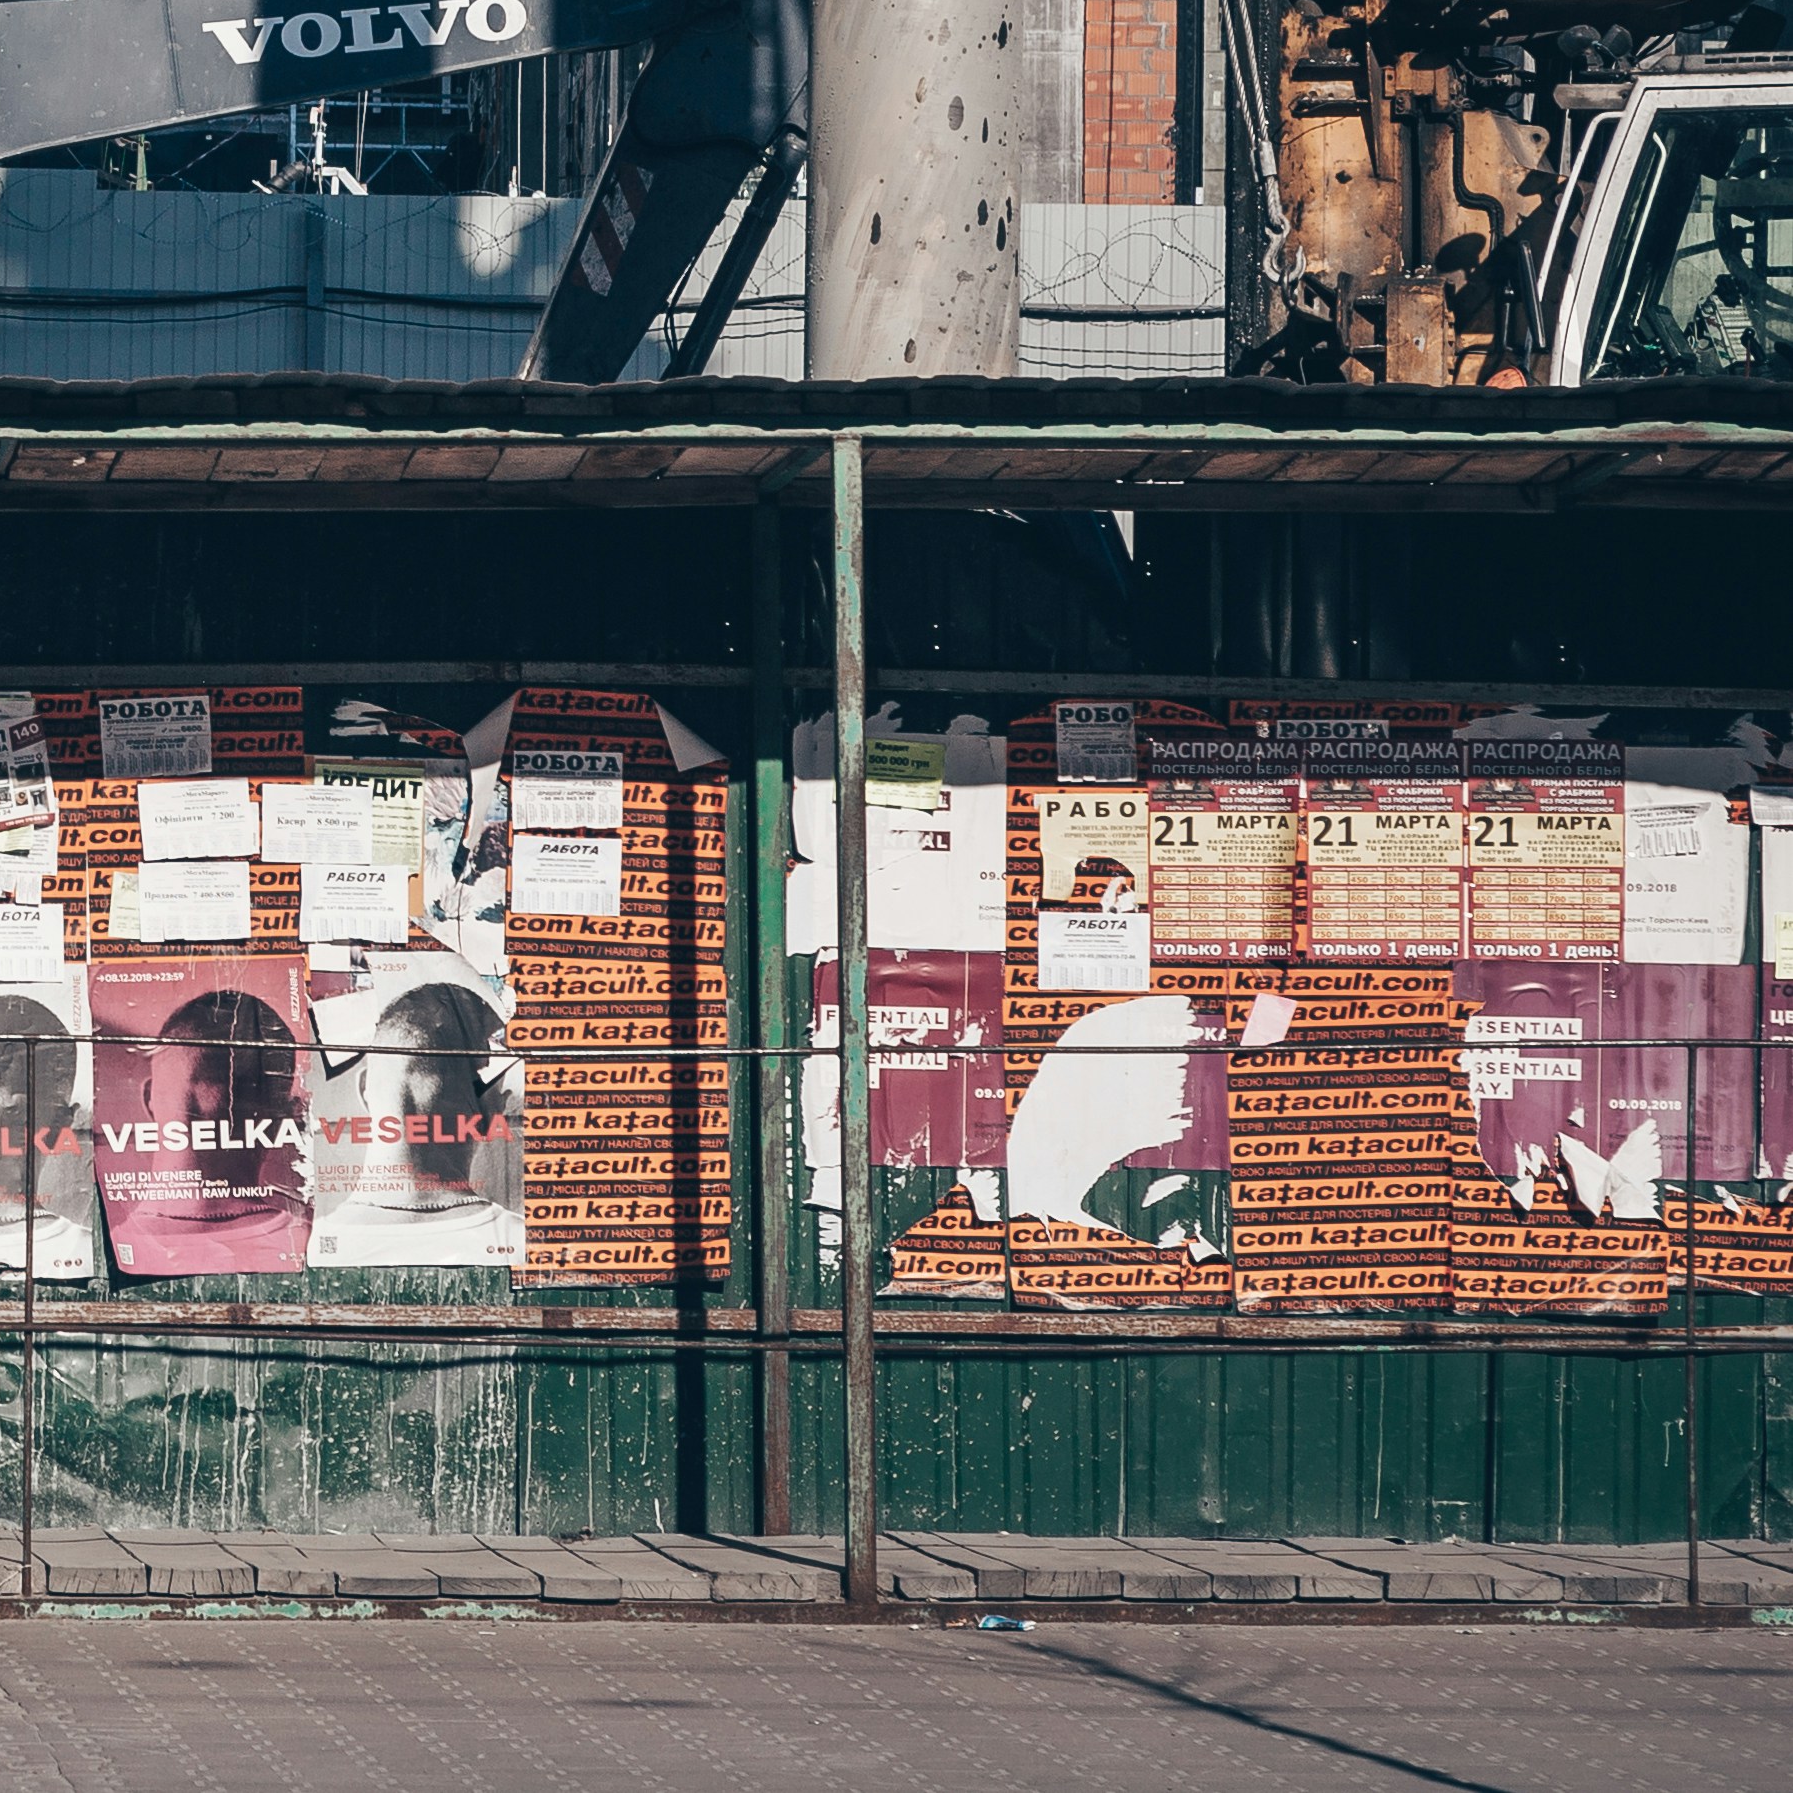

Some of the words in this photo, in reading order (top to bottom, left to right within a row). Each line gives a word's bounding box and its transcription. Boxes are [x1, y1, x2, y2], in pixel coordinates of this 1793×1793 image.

[103, 700, 208, 720] РОБОТА
[13, 722, 39, 739] 140
[1152, 742, 1298, 762] РАСПРОДАЖА
[1311, 742, 1460, 762] РАСПРОДАЖА
[1472, 743, 1621, 763] РАСПРОДАЖА
[514, 753, 621, 772] РОБОТА
[868, 755, 887, 765] 500
[888, 756, 909, 766] 000
[1152, 765, 1252, 774] ПОСТЕЛЬНОГО
[1257, 765, 1298, 774] БЕЛЬЯ
[1311, 764, 1411, 774] ПОСТЕЛЬНОГО
[1415, 764, 1459, 774] БЕЛЬЯ
[1472, 765, 1572, 775] ПОСТЕЛЬНОГО
[1577, 766, 1621, 775] БЕЛЬЯ
[277, 817, 306, 827] Касир
[324, 818, 341, 826] 500
[1154, 815, 1199, 847] 21
[1217, 815, 1290, 829] МАРТА
[1313, 815, 1358, 847] 21
[1376, 815, 1450, 829] МАРТА
[1474, 816, 1519, 847] 21
[1537, 816, 1612, 830] МАРТА
[540, 844, 600, 856] РАБОТА
[326, 871, 387, 883] РАБОТА
[1067, 919, 1128, 930] РАБОТА
[1153, 943, 1224, 956] только
[1229, 942, 1239, 955] 1
[1245, 942, 1292, 958] день!
[1312, 944, 1381, 956] только
[1388, 943, 1398, 956] 1
[1404, 942, 1459, 958] день!
[1473, 944, 1542, 956] только
[1549, 943, 1558, 956] 1
[1565, 942, 1619, 959] день!
[509, 1025, 574, 1041] com
[1609, 1100, 1682, 1110] 09.09.2018
[101, 1118, 307, 1153] VESELKA
[318, 1113, 513, 1145] VESELKA
[1233, 1141, 1300, 1157] com
[104, 1172, 136, 1183] LUIGI
[138, 1172, 151, 1182] DI
[153, 1170, 202, 1182] VENERE
[318, 1165, 350, 1175] LUIGI
[352, 1165, 364, 1175] DI
[366, 1164, 413, 1175] VENERE
[107, 1190, 128, 1201] S.A.
[129, 1188, 192, 1201] TWEEMAN
[202, 1187, 229, 1199] RAW
[232, 1186, 274, 1198] UNKUT
[318, 1182, 341, 1193] S.A.
[343, 1182, 404, 1193] TWEEMAN
